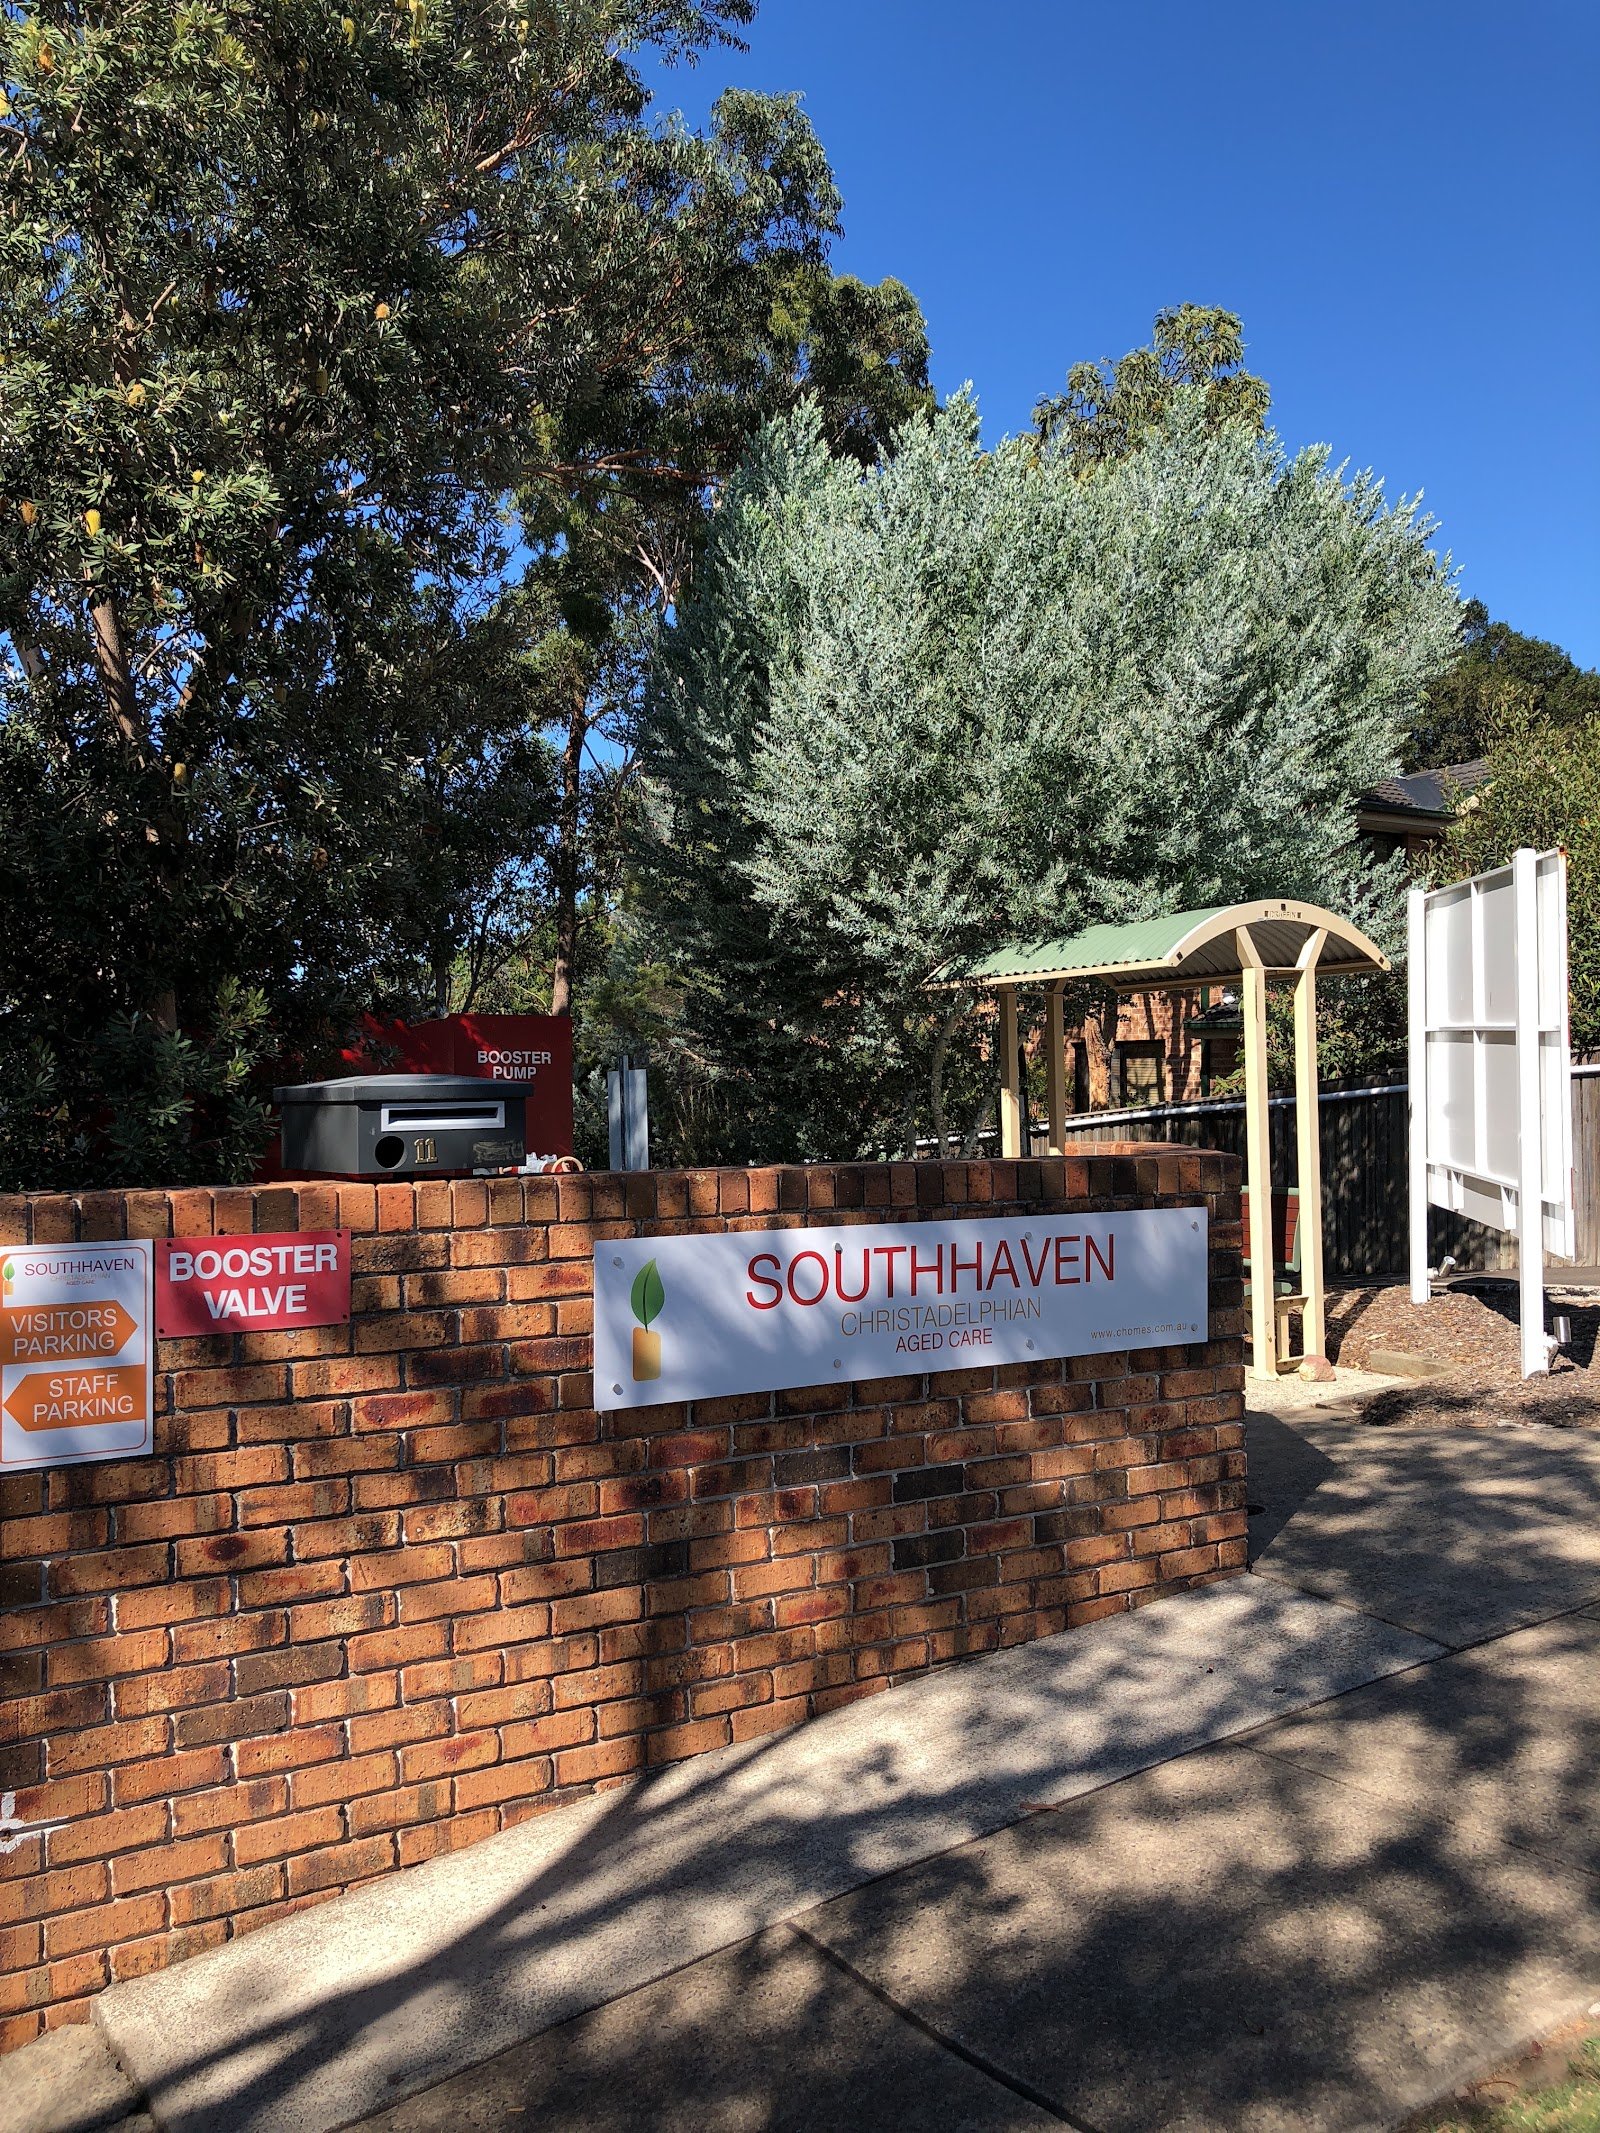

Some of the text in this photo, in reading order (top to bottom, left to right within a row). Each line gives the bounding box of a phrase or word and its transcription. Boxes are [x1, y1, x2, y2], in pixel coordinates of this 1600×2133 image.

[477, 1050, 552, 1064] BOOSTER
[493, 1066, 536, 1079] PUMP
[414, 1138, 438, 1164] 11
[24, 1258, 135, 1276] SOUTHHAVEN
[169, 1243, 338, 1282] BOOSTER
[746, 1233, 1114, 1310] SOUTHHAVEN
[203, 1284, 308, 1320] VALVE
[10, 1308, 118, 1334] VISITORS
[841, 1296, 1041, 1336] CHRISTADELPHIAN
[14, 1331, 115, 1357] PARKING
[895, 1327, 993, 1354] AGED CARE
[1090, 1322, 1187, 1340] www.chomes.com.au
[49, 1374, 119, 1398] STAFF
[33, 1395, 134, 1423] PARKING
